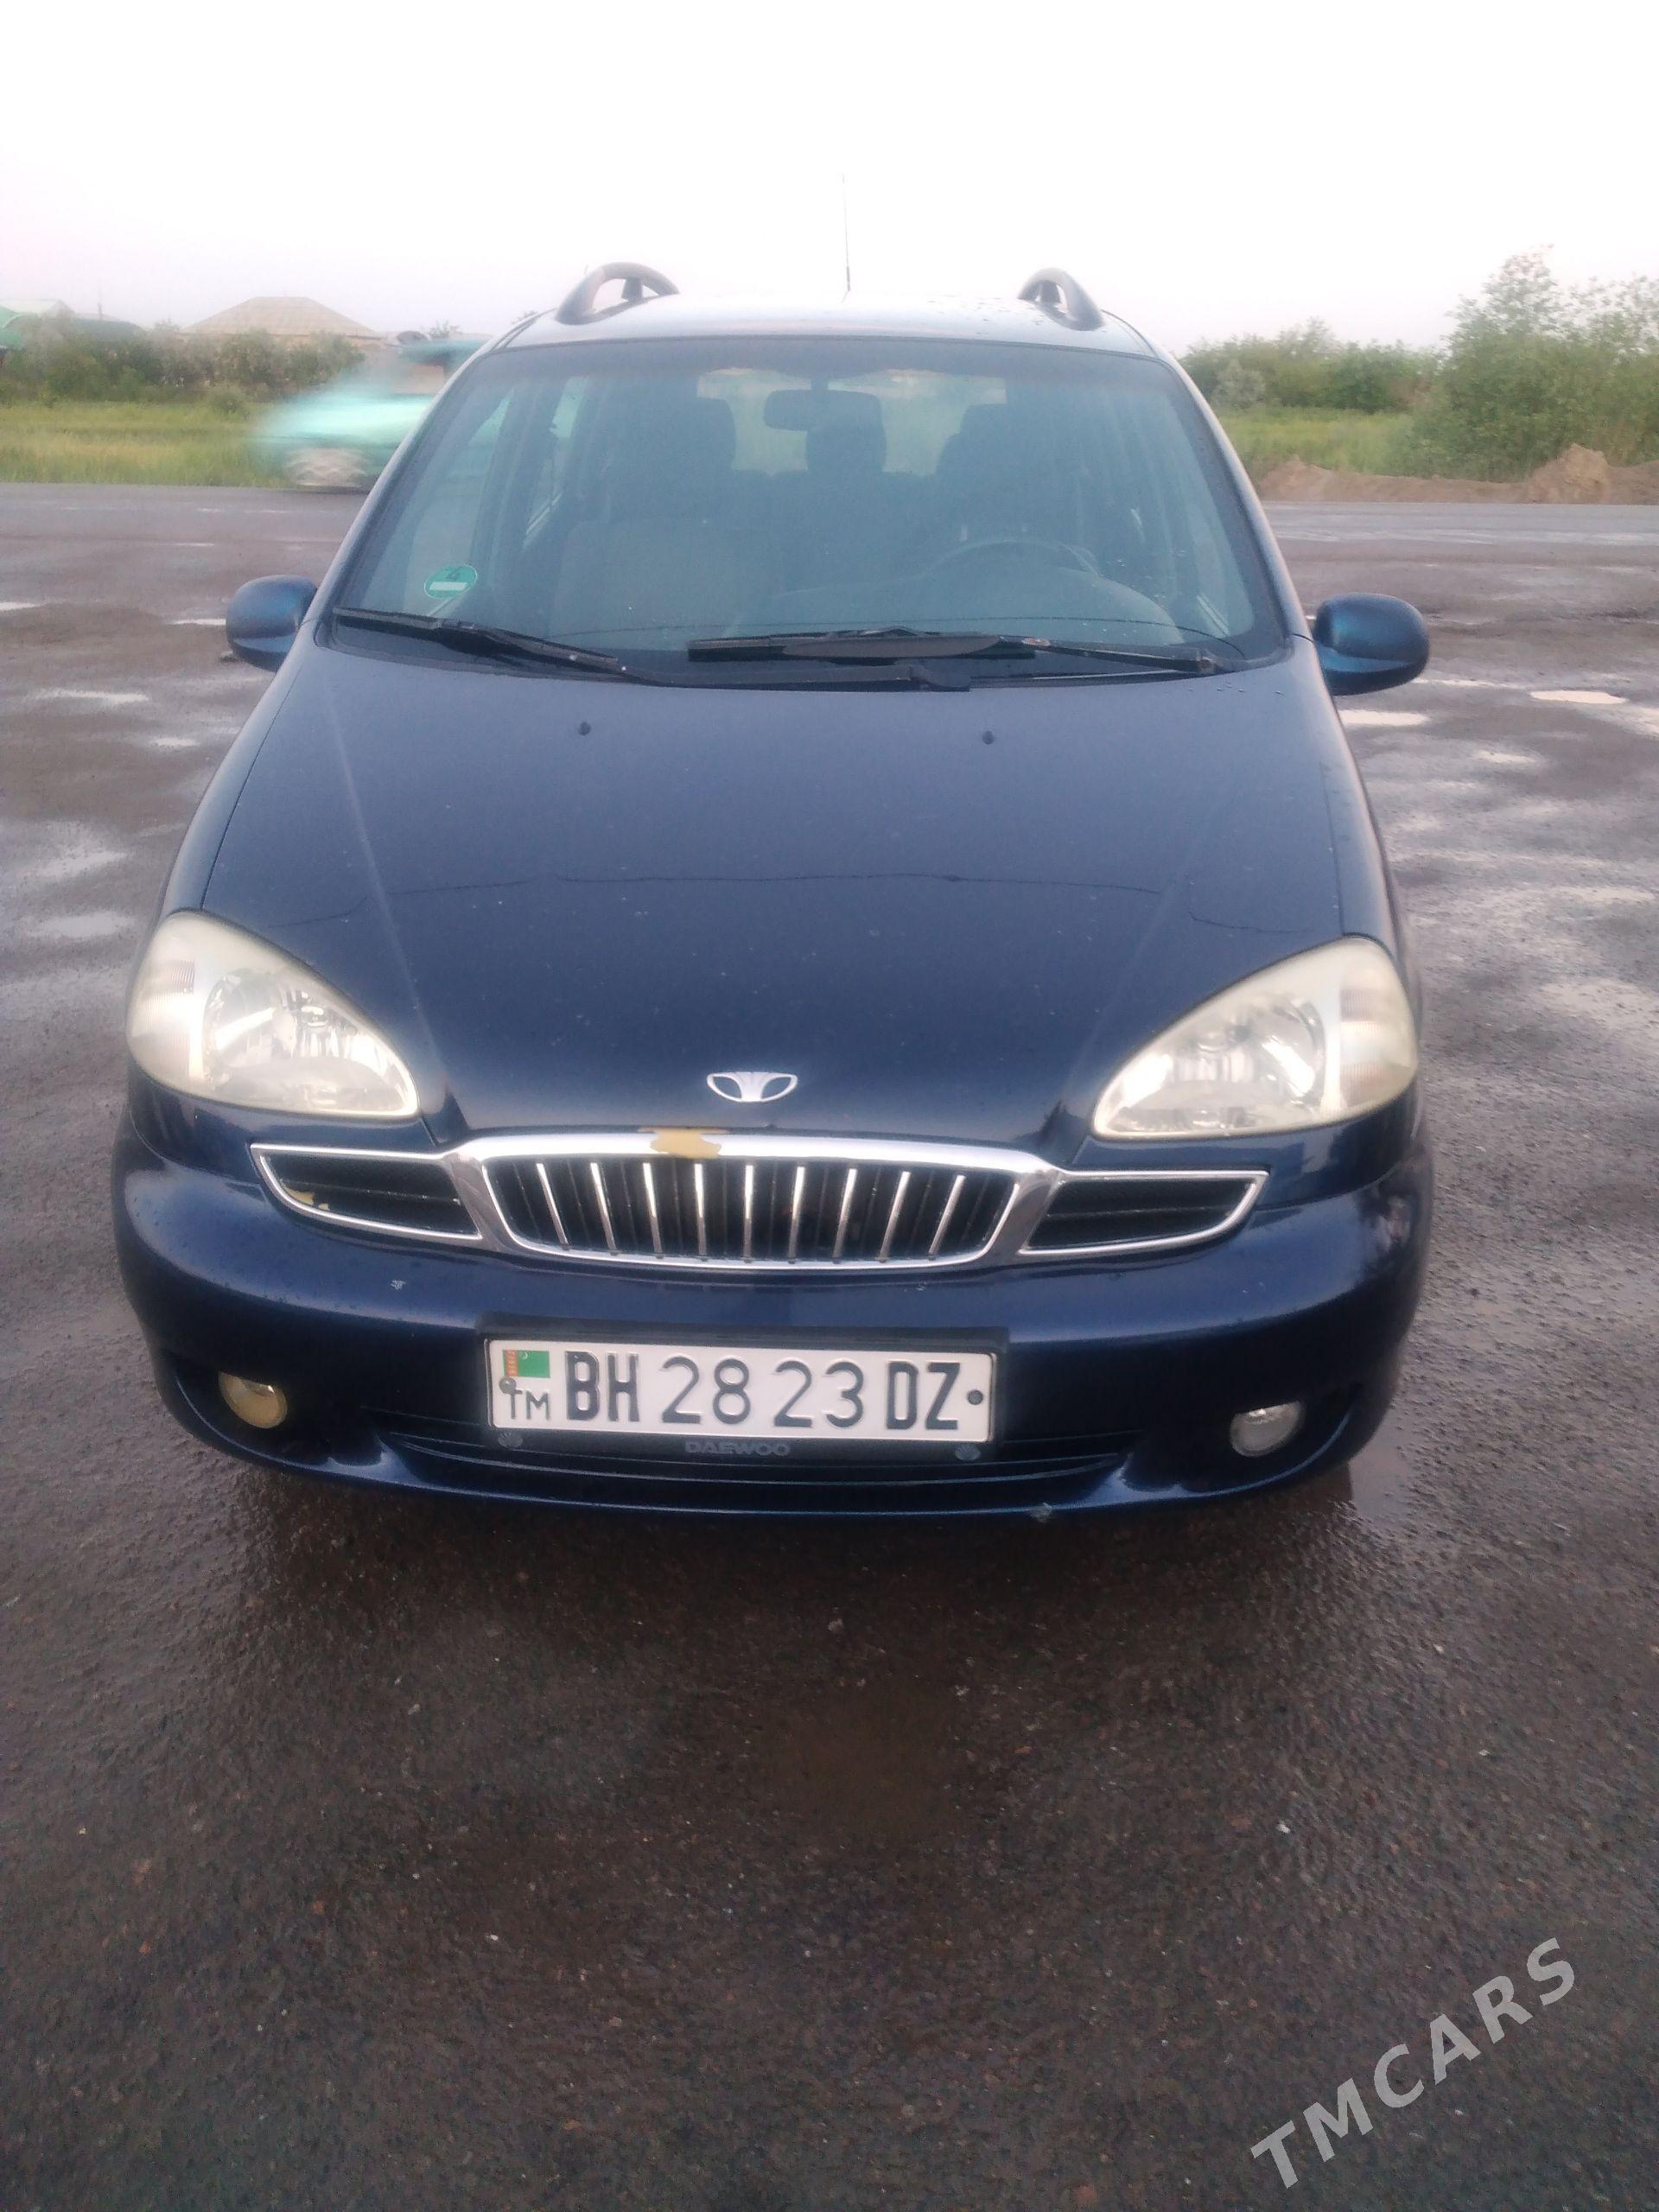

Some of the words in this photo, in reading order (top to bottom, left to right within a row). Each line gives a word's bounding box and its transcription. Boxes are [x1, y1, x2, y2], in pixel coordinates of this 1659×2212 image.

[505, 1388, 550, 1420] TM
[565, 1351, 639, 1421] BH
[887, 1362, 960, 1430] DZ
[684, 1441, 791, 1456] DAEWOO
